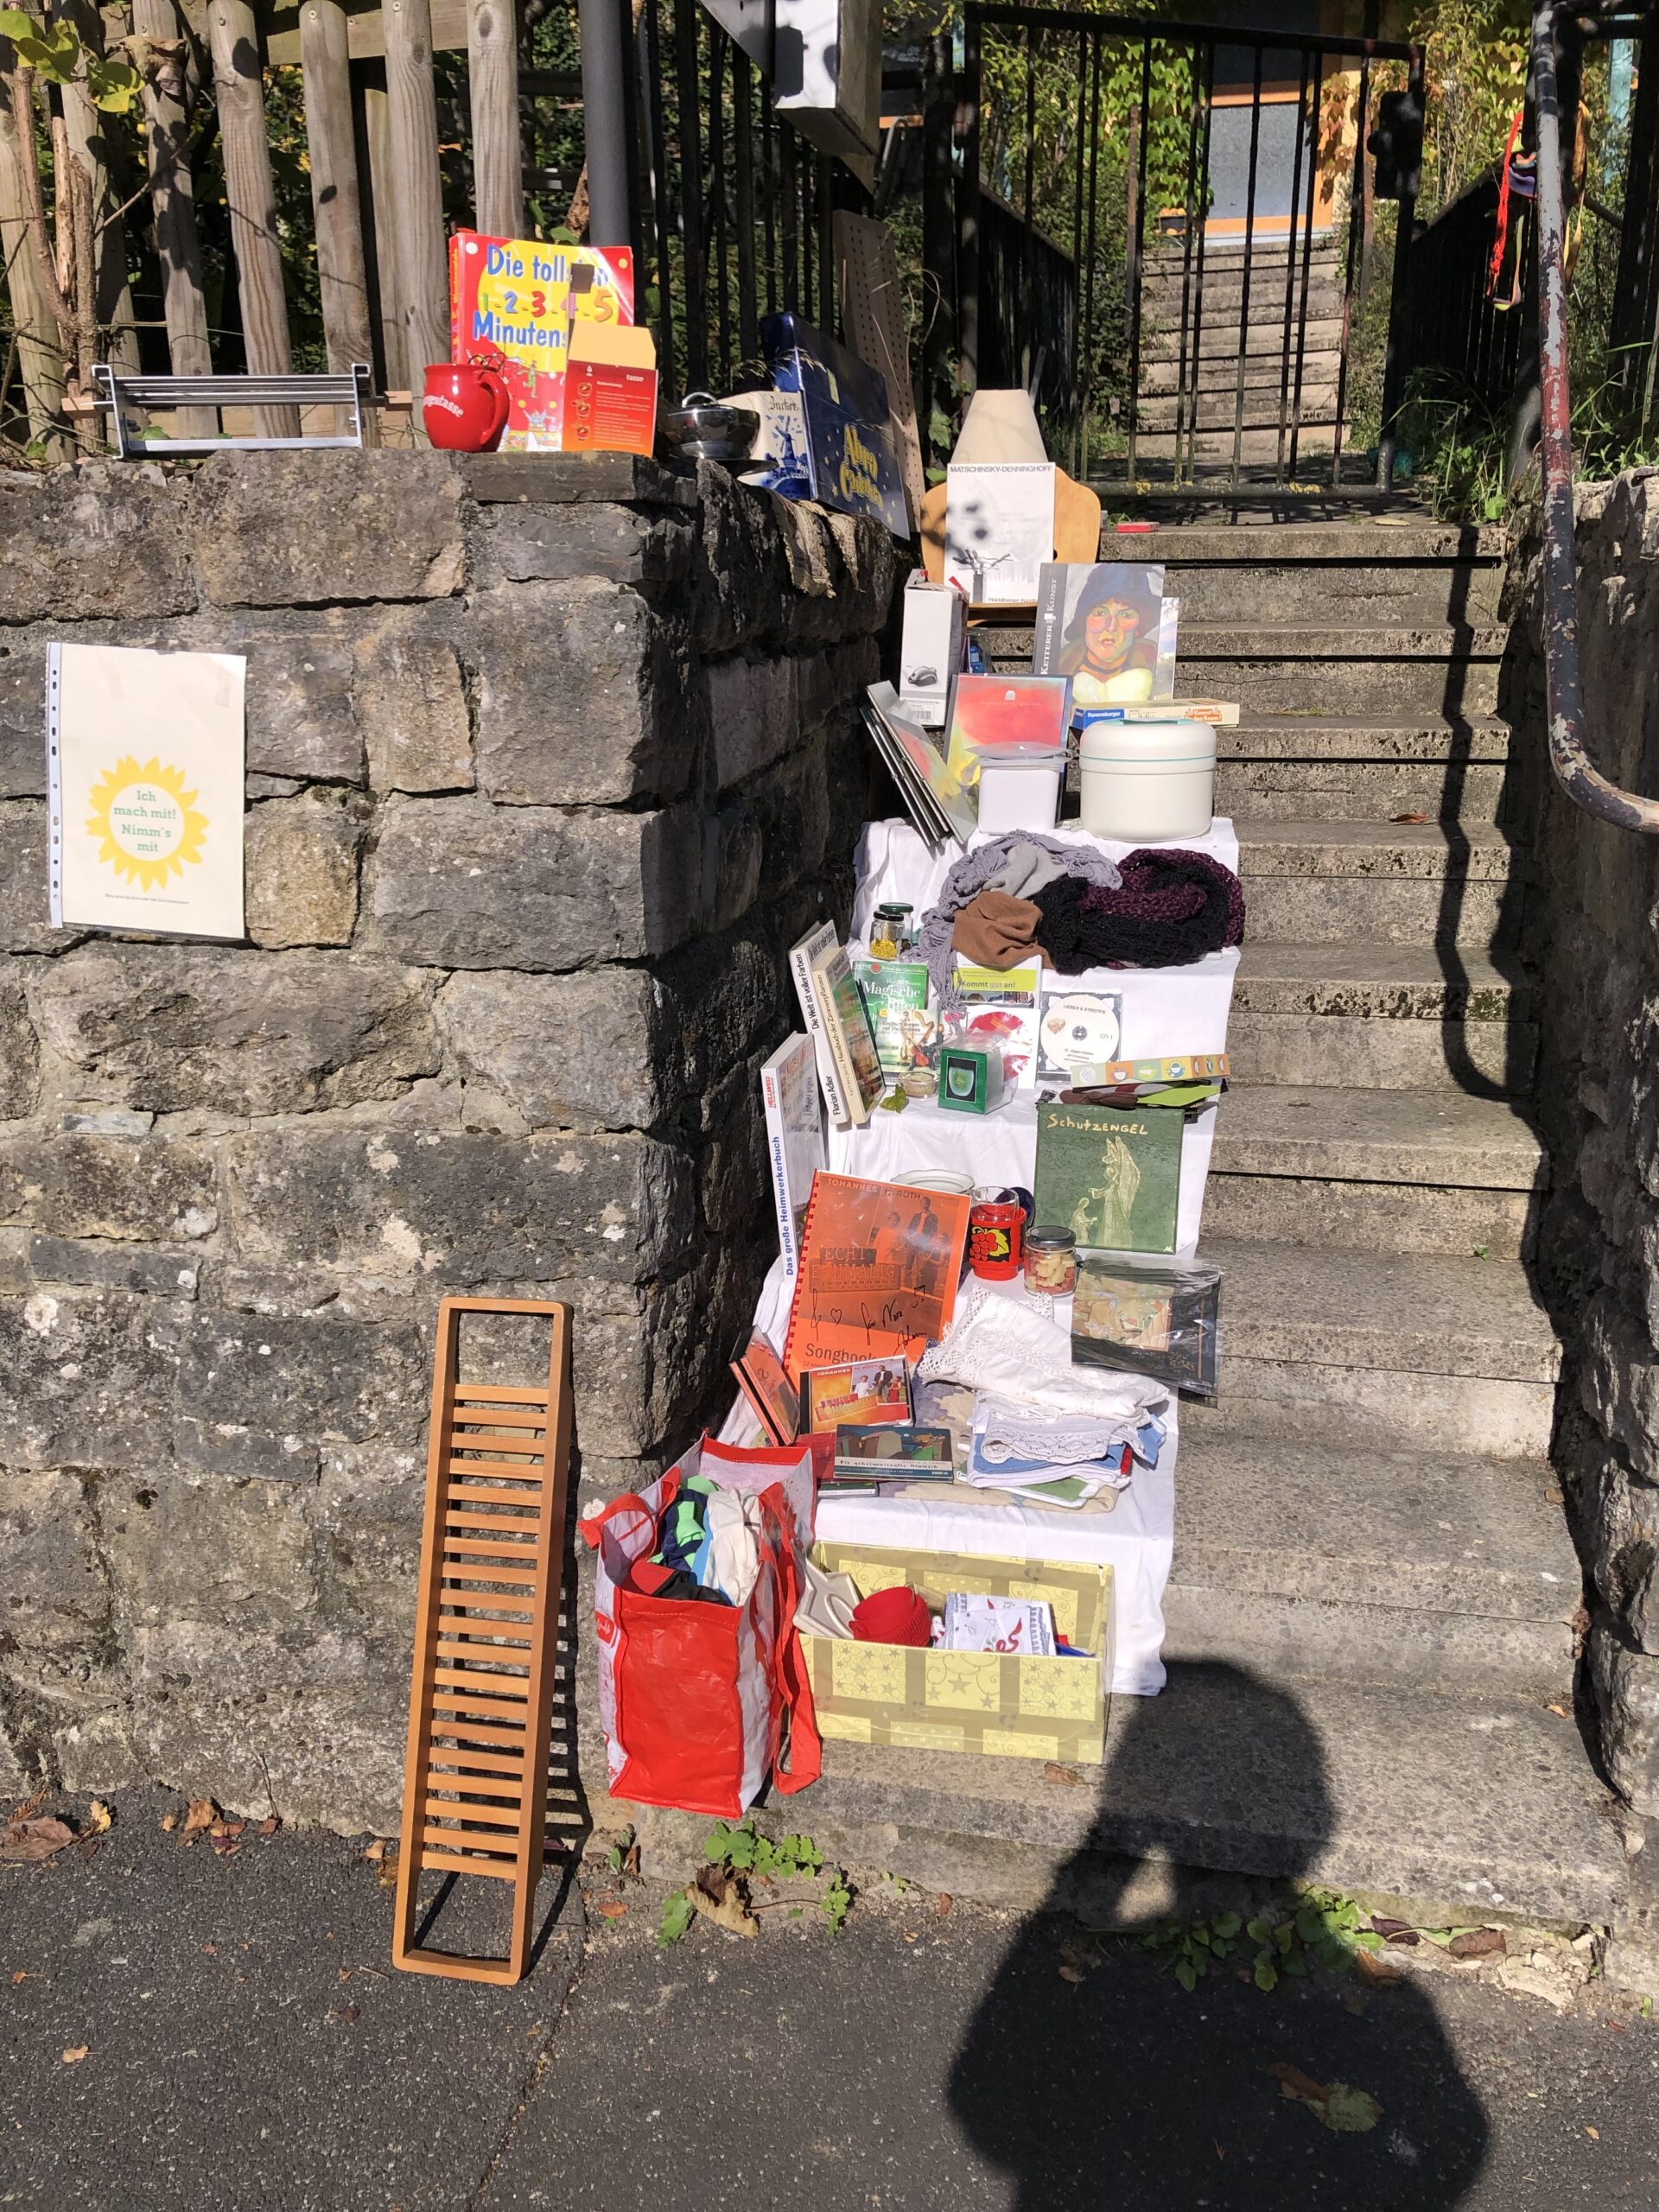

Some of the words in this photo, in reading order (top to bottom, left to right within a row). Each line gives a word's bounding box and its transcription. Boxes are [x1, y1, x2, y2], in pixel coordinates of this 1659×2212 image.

[486, 244, 523, 277] Die
[1046, 579, 1058, 613] KUNST
[1039, 622, 1054, 675] KETTERER
[136, 789, 156, 803] Ich
[113, 806, 148, 817] mach
[150, 808, 176, 820] mit!
[137, 842, 159, 853] mit
[796, 954, 806, 977] Farben
[800, 976, 810, 995] voller
[863, 981, 920, 1000] Magische
[804, 993, 813, 1003] ist
[817, 974, 834, 1023] Zimmerpflanzen
[805, 1002, 817, 1019] Welt
[810, 1017, 820, 1030] Die
[832, 1033, 845, 1062] Hausbuch
[765, 1076, 773, 1109] HELLWEG
[826, 1075, 836, 1094] Adler
[829, 1092, 841, 1116] Florian
[772, 1135, 789, 1223] Heimwerkerbuch
[827, 1178, 879, 1193] JOHANNES
[896, 1189, 921, 1200] ROTH
[780, 1225, 792, 1255] große
[824, 1245, 867, 1261] ECHT
[785, 1256, 794, 1276] Das
[817, 1368, 851, 1376] JOHANNES
